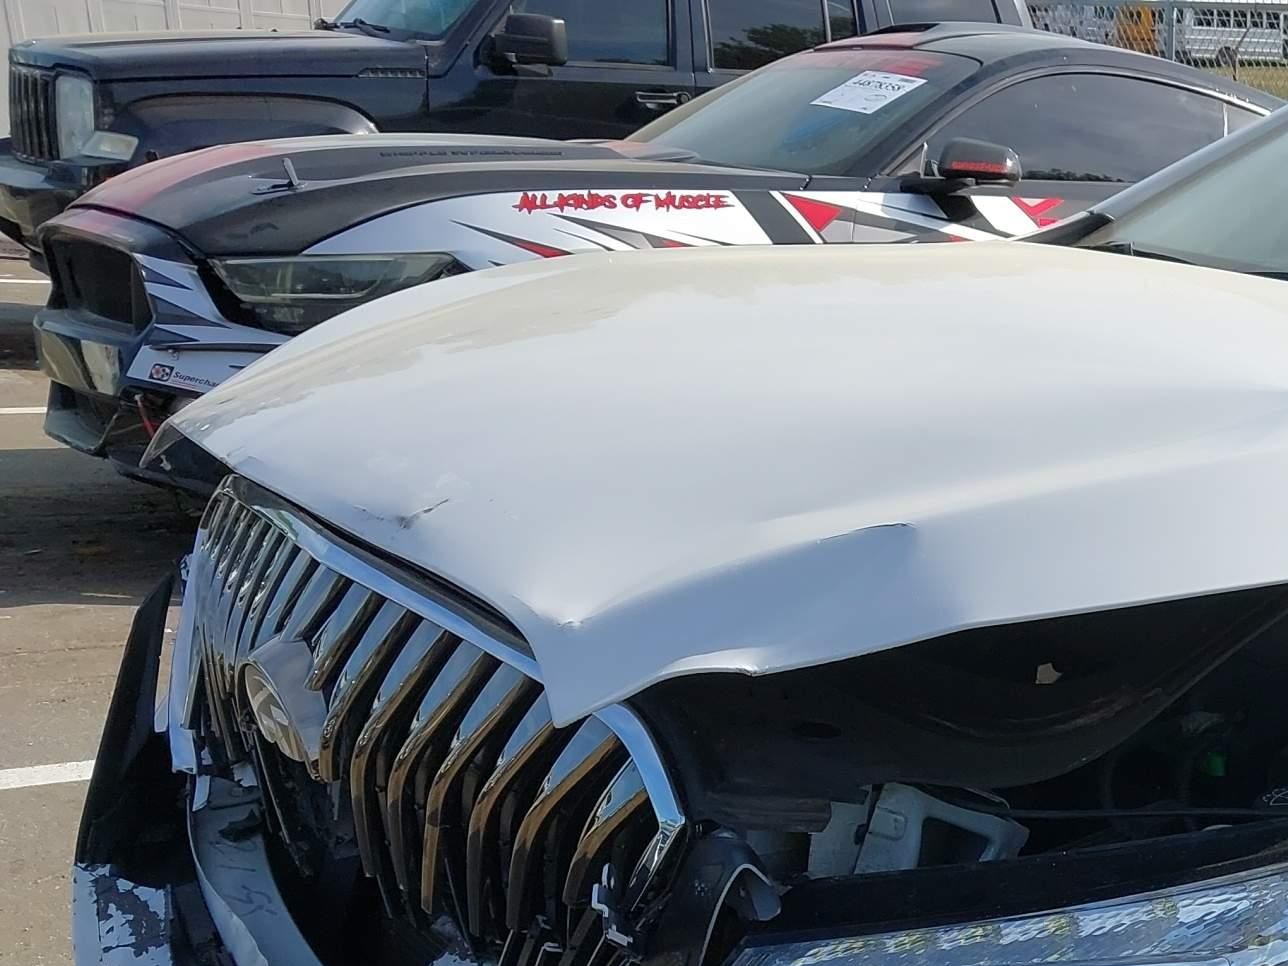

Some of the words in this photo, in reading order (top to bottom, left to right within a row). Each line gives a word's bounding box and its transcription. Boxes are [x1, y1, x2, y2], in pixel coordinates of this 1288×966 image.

[512, 191, 553, 214] ALL
[553, 190, 618, 212] KINDS
[620, 192, 655, 211] OF
[655, 190, 735, 212] MUSCLE
